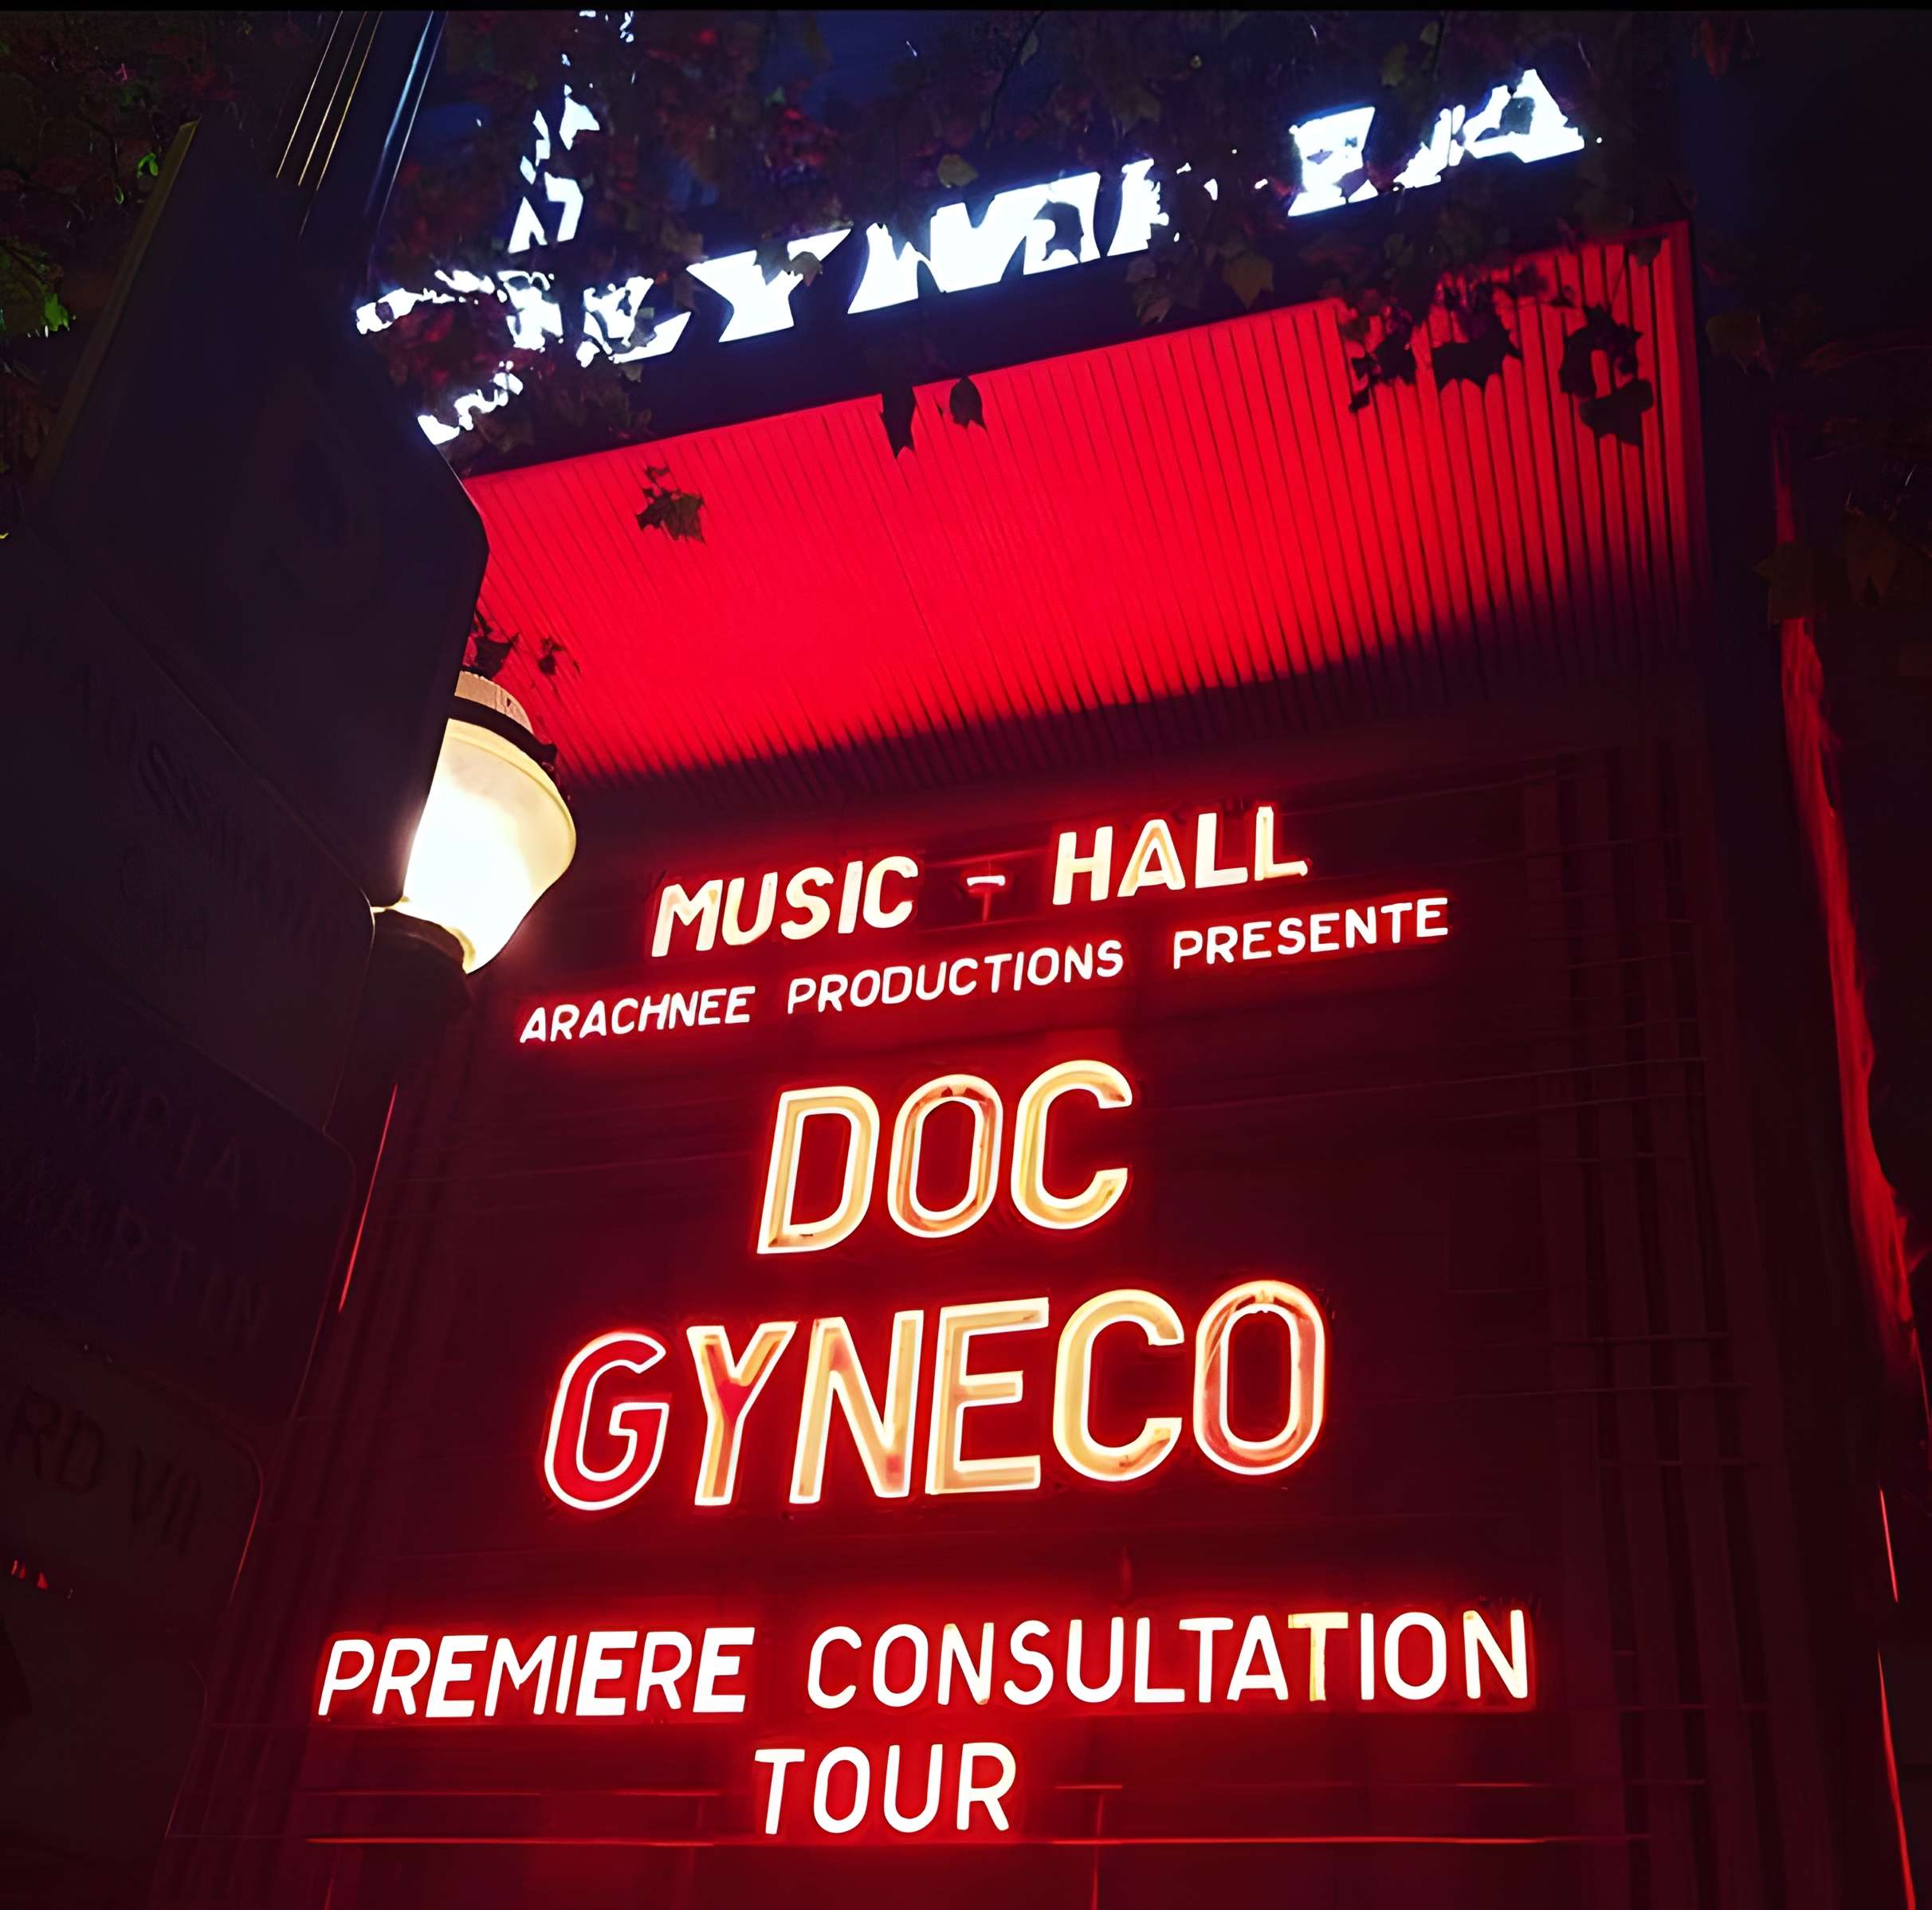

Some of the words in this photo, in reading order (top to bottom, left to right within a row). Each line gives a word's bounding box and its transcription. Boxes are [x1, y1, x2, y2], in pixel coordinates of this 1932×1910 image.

[652, 856, 918, 957] MUSIC
[1053, 807, 1308, 905] HALL
[520, 986, 755, 1043] ARACHNEE
[786, 939, 1123, 1014] PRODUCTIONS
[1174, 898, 1447, 969] PRESENTE
[757, 1060, 1133, 1254] DOC
[544, 1280, 1325, 1511] GYNECO
[319, 1627, 755, 1717] PREMIERE
[808, 1609, 1527, 1708] CONSULTATION
[755, 1743, 1015, 1834] TOUR
